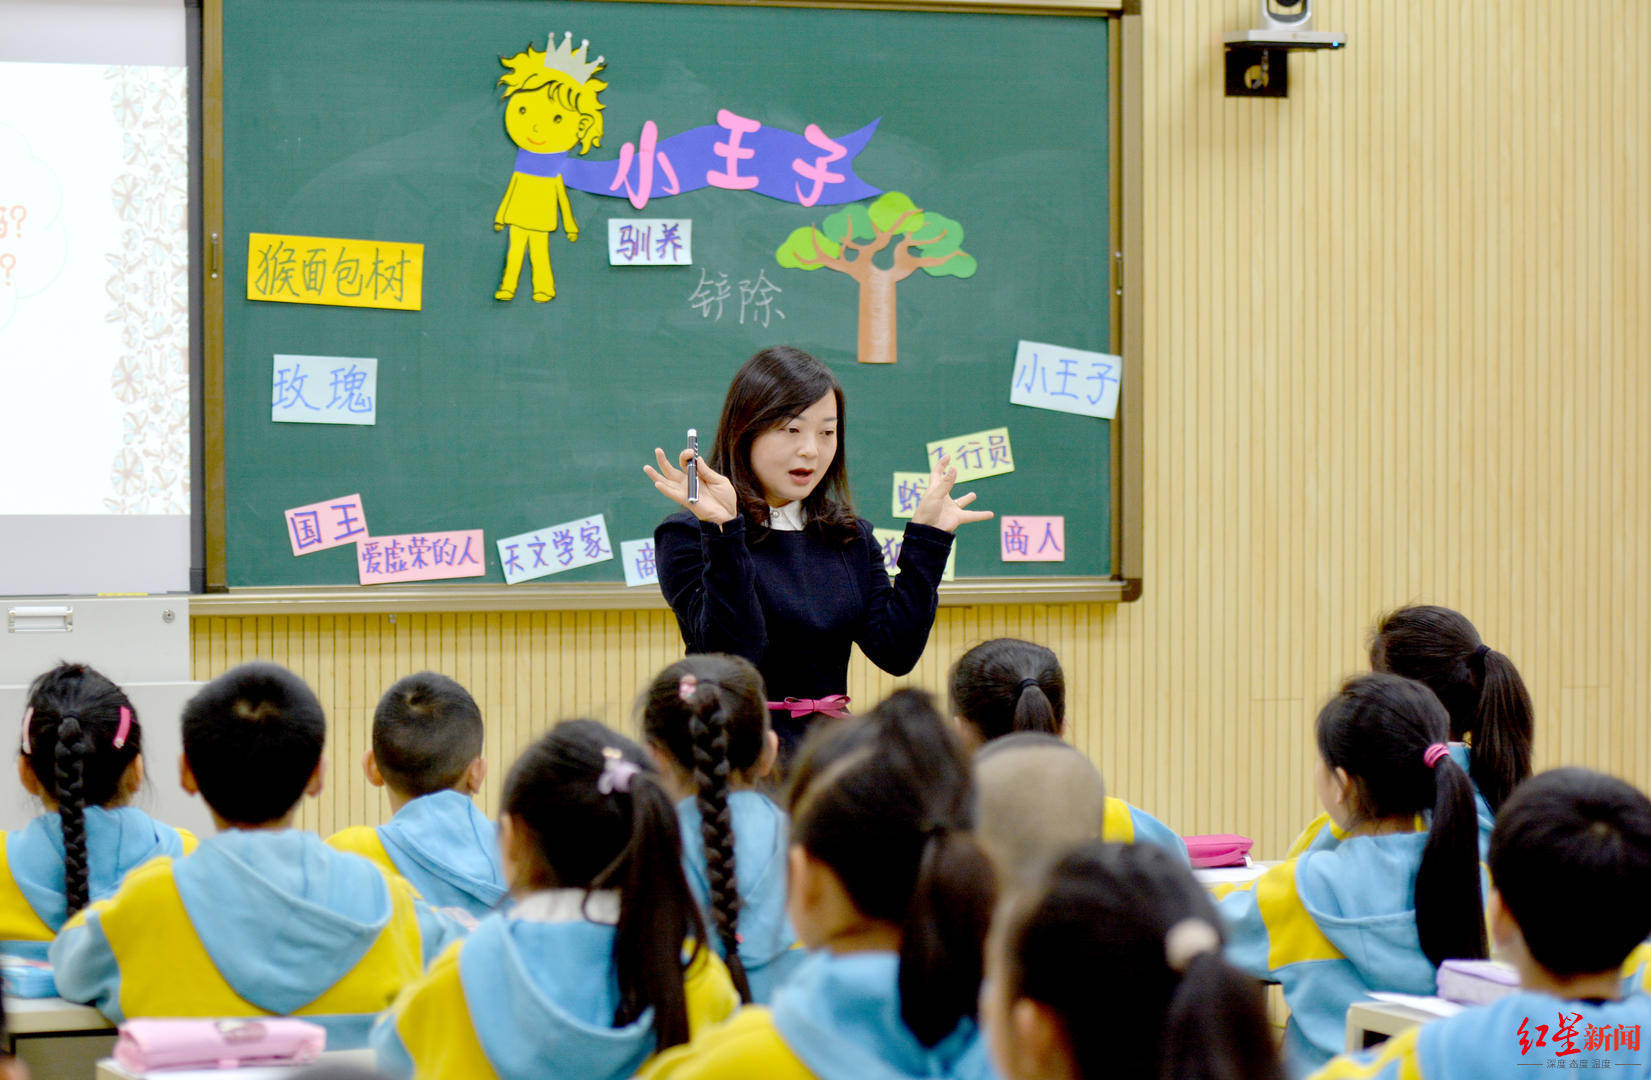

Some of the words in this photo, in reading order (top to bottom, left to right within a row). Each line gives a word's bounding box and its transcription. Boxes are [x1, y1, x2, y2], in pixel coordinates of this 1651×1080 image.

[609, 109, 848, 209] 小王子
[617, 222, 683, 261] 驯养
[255, 240, 411, 302] 猴面包树
[688, 267, 785, 328] 铲除
[272, 363, 373, 413] 玫瑰
[1015, 353, 1118, 405] 小王子
[290, 503, 366, 550] 国王
[503, 521, 611, 576] 天文学家
[1004, 520, 1062, 556] 商人
[360, 535, 480, 576] 爱虚荣的人
